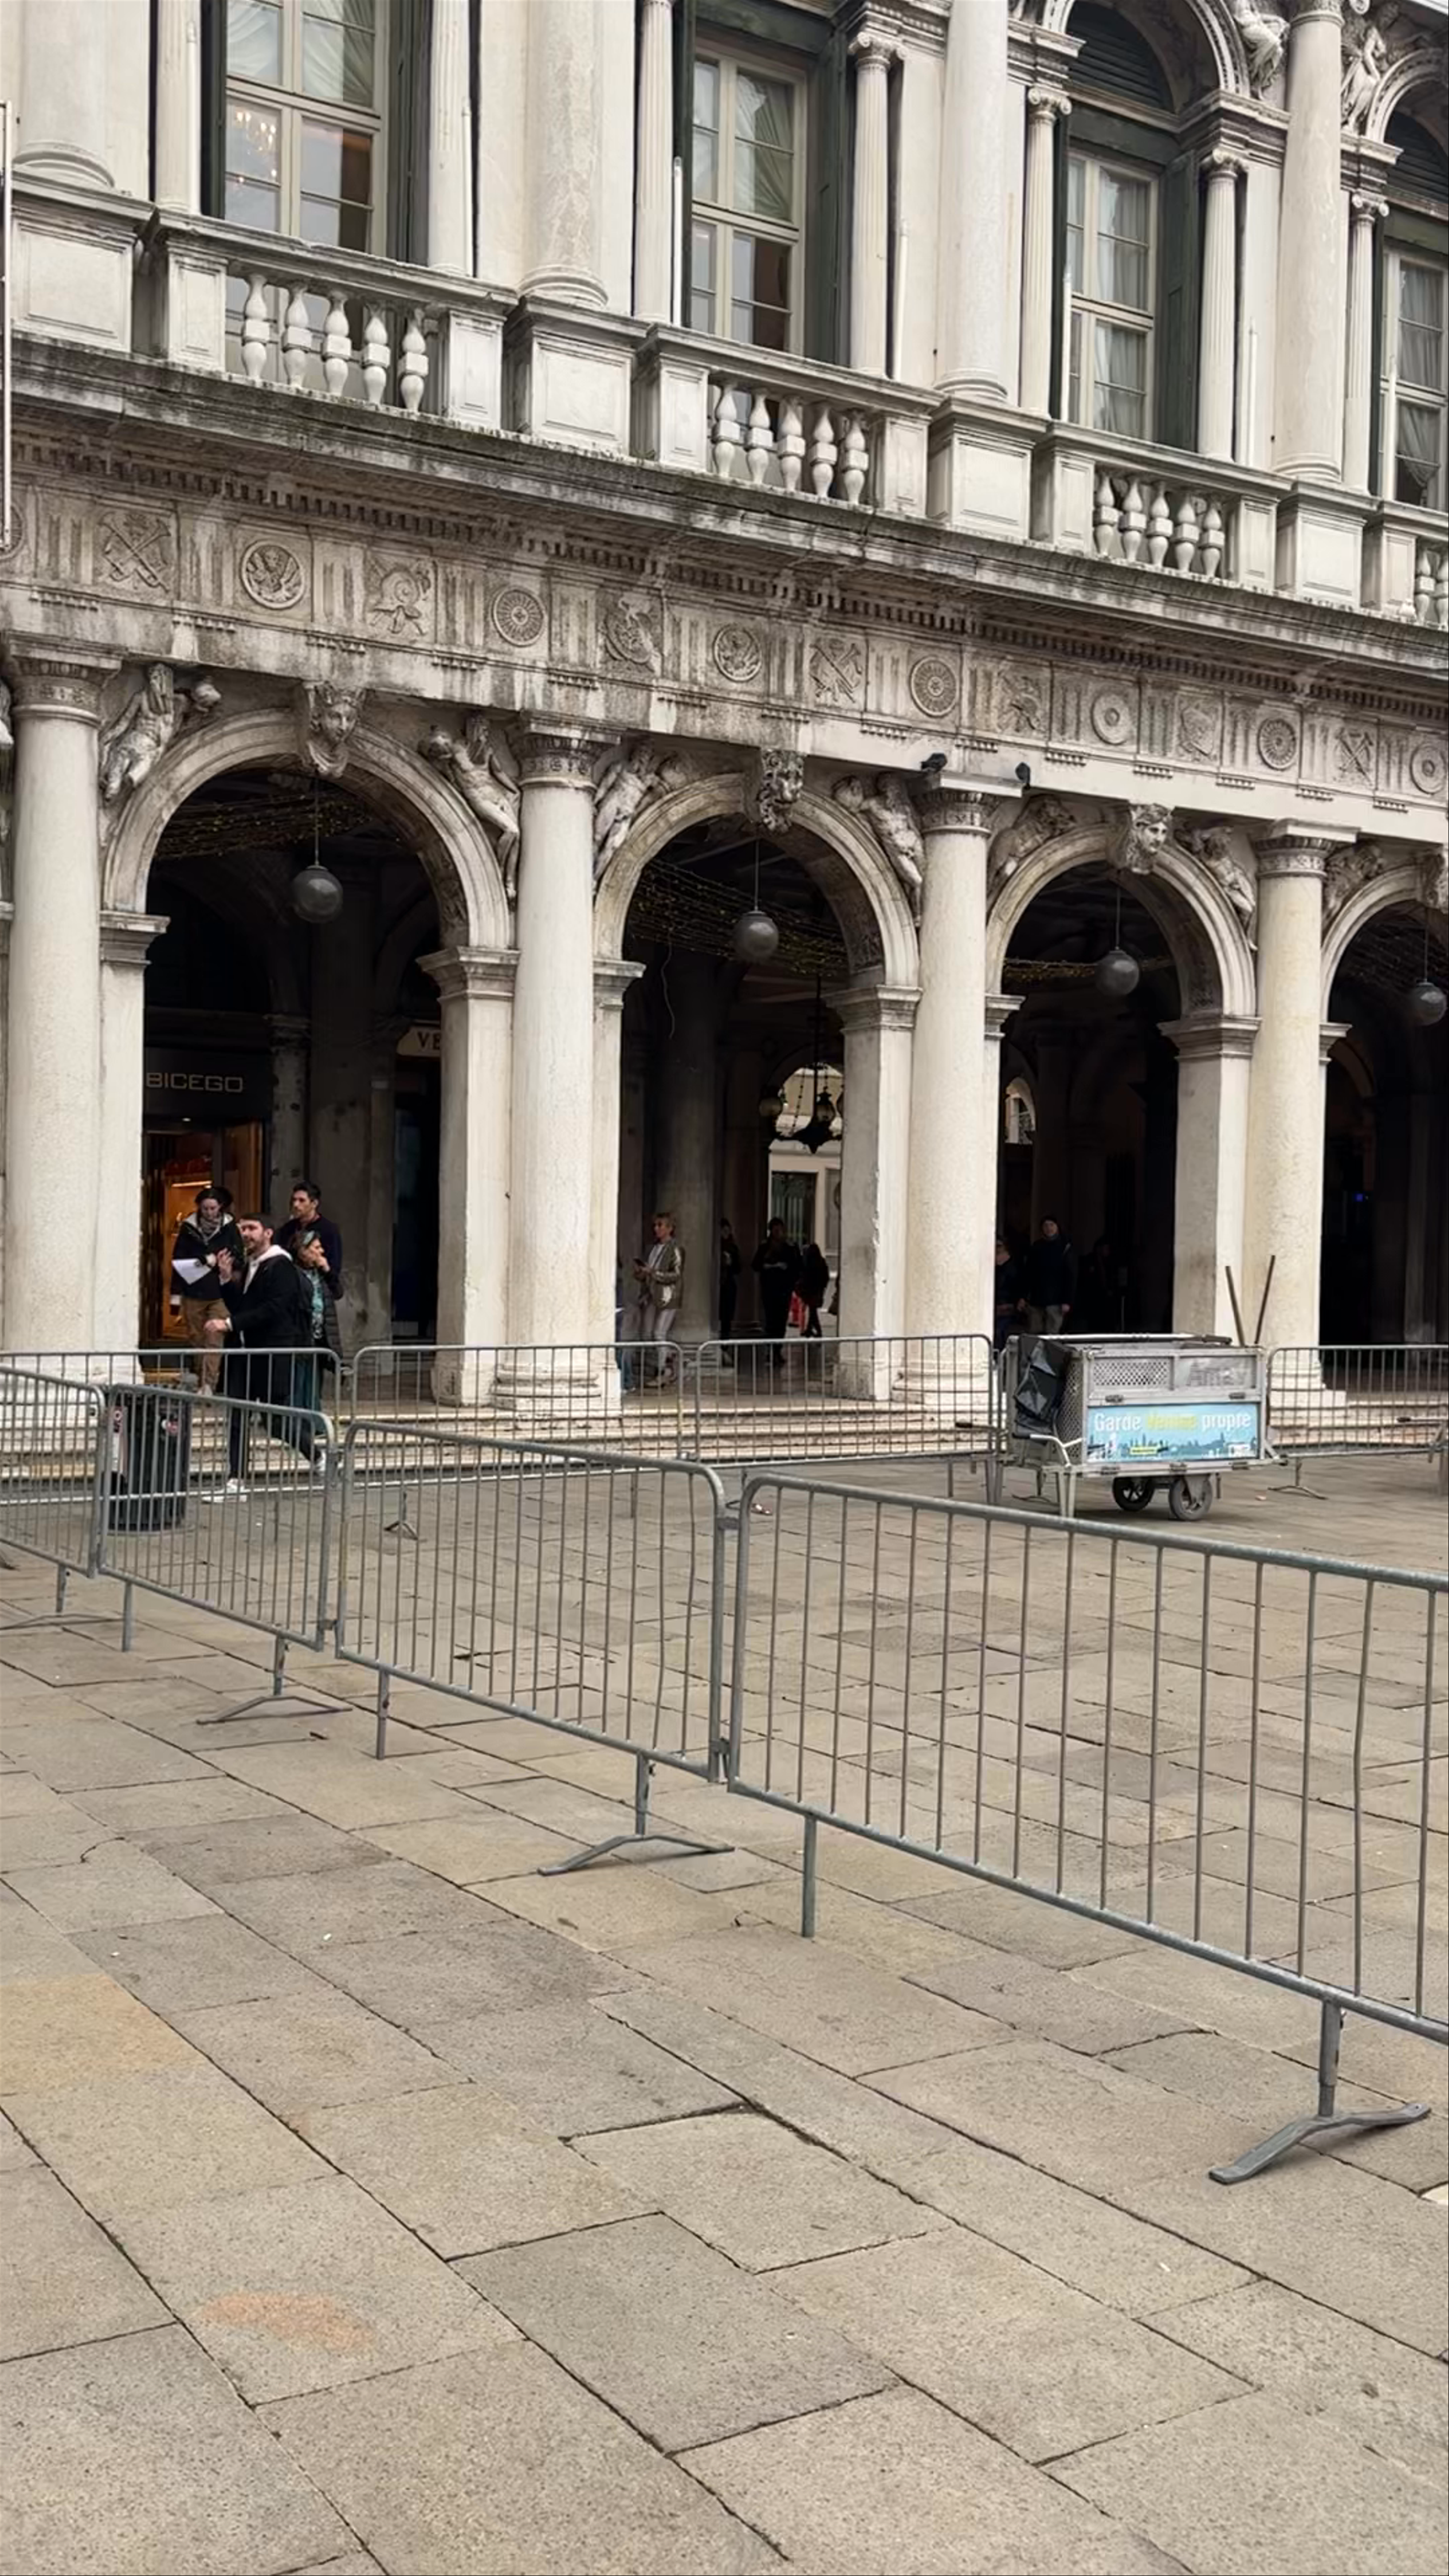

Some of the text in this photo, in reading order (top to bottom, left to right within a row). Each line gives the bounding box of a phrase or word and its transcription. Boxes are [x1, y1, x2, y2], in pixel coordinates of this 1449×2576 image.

[146, 1072, 243, 1092] BICEGO
[1095, 1413, 1141, 1431] Garde
[1201, 1412, 1251, 1432] propre
